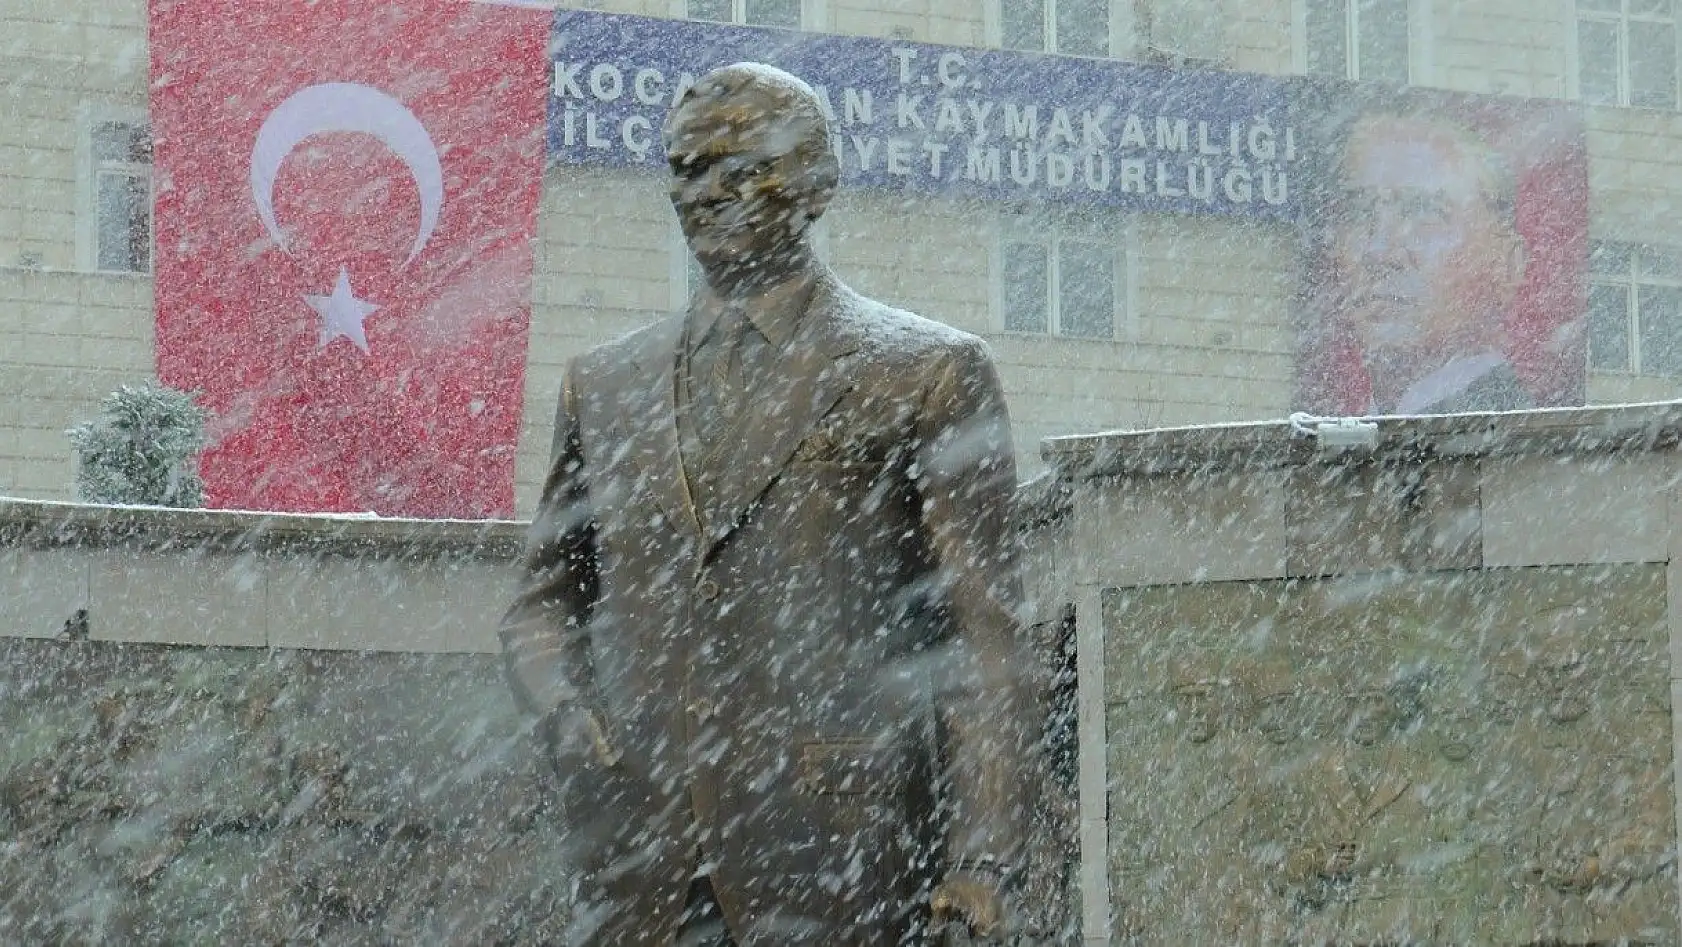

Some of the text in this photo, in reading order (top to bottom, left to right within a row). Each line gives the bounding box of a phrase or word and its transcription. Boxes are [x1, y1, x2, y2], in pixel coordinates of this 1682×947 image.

[891, 48, 981, 89] T.C.
[564, 101, 653, 162] İLÇ
[967, 142, 1288, 205] MÜDÜRLÜĞÜ
[898, 93, 1295, 161] KAYMAKAMLIĞI
